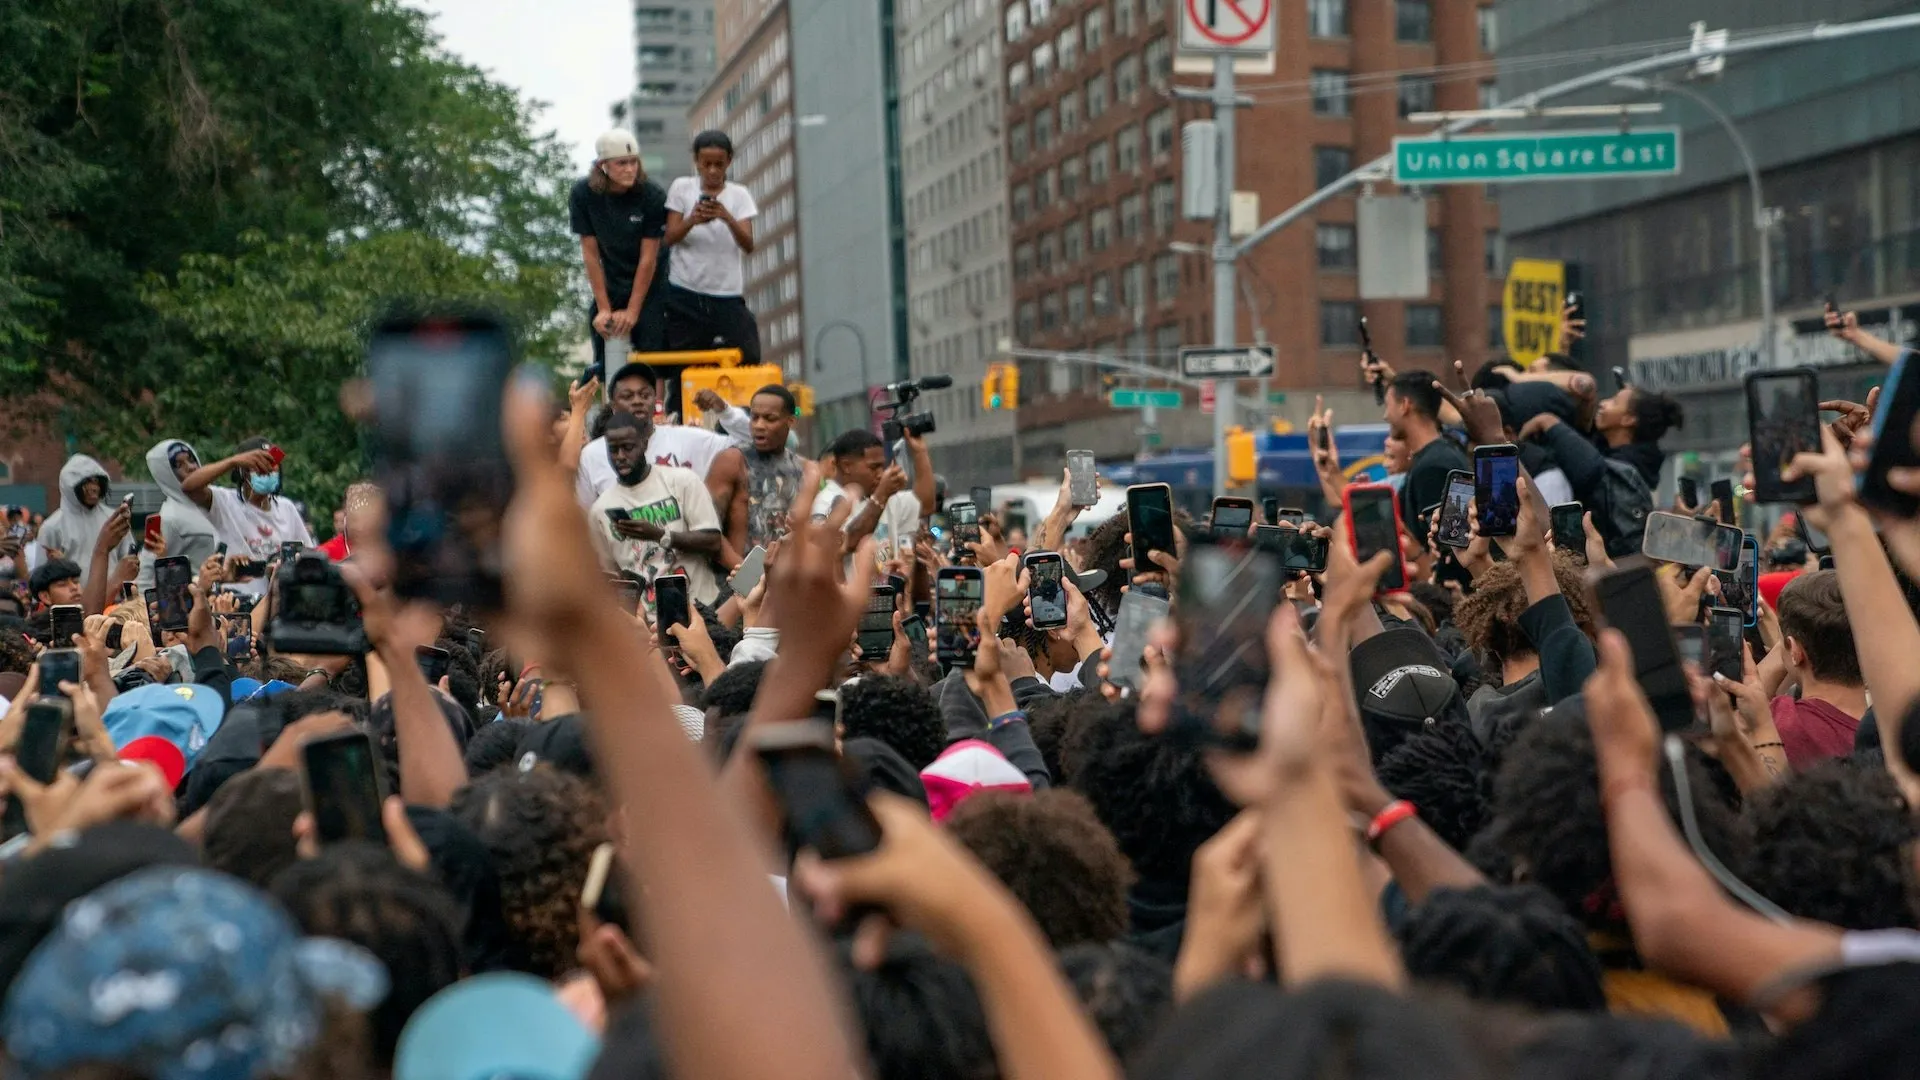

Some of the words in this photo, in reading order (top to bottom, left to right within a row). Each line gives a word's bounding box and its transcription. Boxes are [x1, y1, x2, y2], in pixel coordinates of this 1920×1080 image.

[1405, 152, 1488, 172] Union
[1496, 147, 1596, 173] Square
[1602, 143, 1665, 165] East
[1512, 280, 1558, 313] BEST
[1514, 320, 1553, 353] BUY
[1191, 358, 1216, 371] ONE
[1232, 356, 1261, 370] WAY
